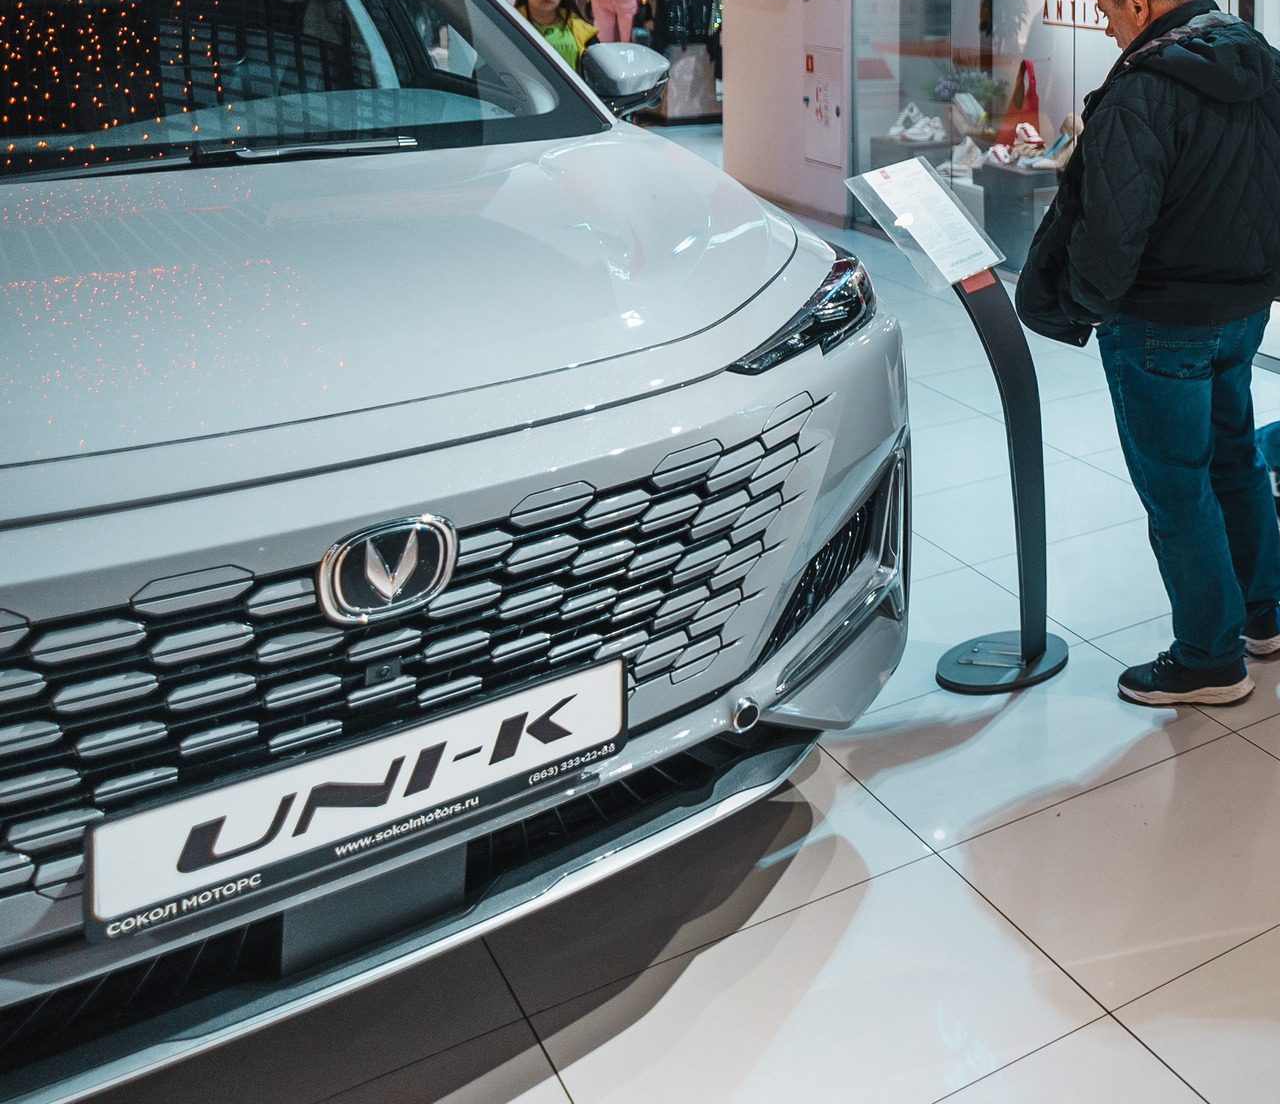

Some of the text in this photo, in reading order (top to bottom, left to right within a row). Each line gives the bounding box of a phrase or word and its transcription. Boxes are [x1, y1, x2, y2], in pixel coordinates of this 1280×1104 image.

[176, 693, 579, 874] UNI-K
[528, 765, 559, 786] (863)
[334, 796, 480, 857] www.sokolmotors.ru
[106, 872, 263, 936] СОКОЛ МОТОРС
